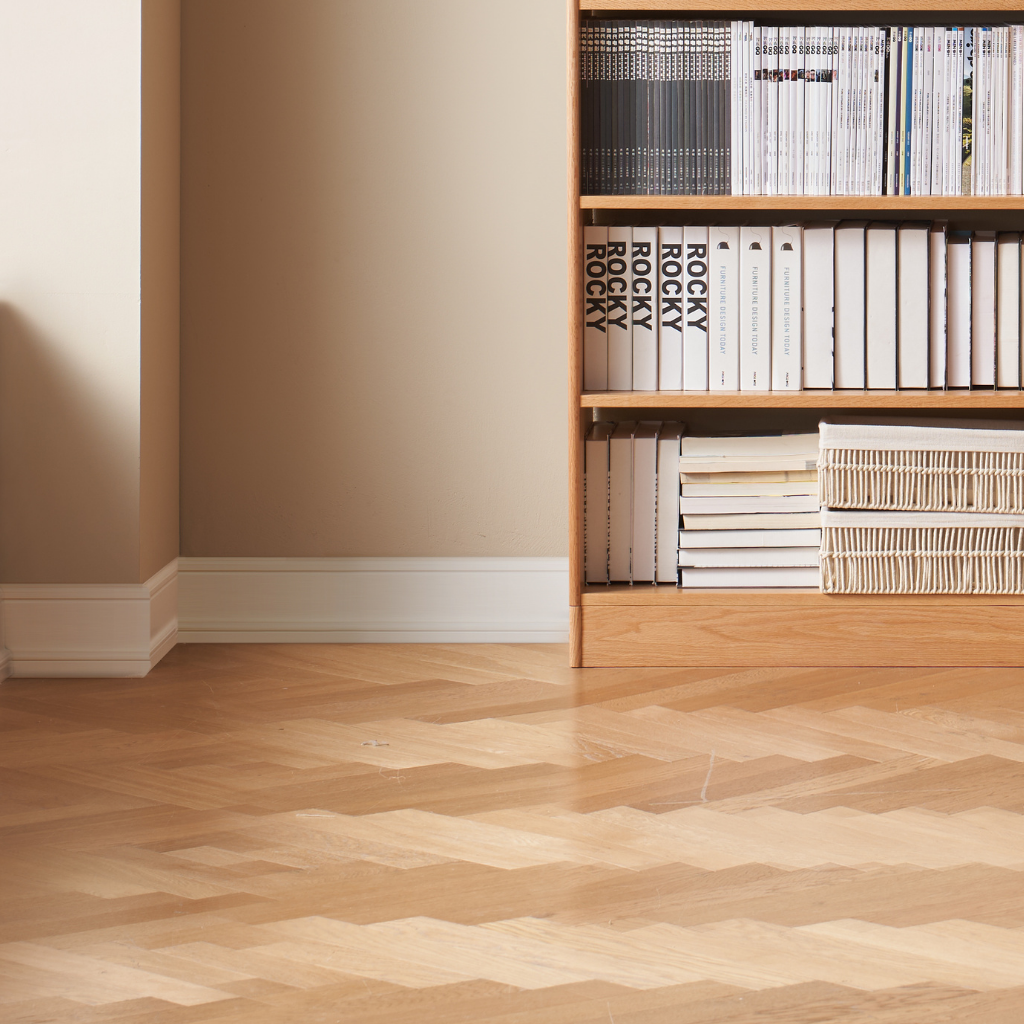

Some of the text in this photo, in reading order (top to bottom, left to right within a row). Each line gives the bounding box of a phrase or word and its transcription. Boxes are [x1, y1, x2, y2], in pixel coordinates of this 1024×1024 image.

[586, 244, 606, 333] ROCKY
[607, 242, 628, 330] ROCKY
[632, 242, 652, 331] ROCKY
[662, 244, 682, 332] ROCKY
[687, 244, 708, 332] ROCKY
